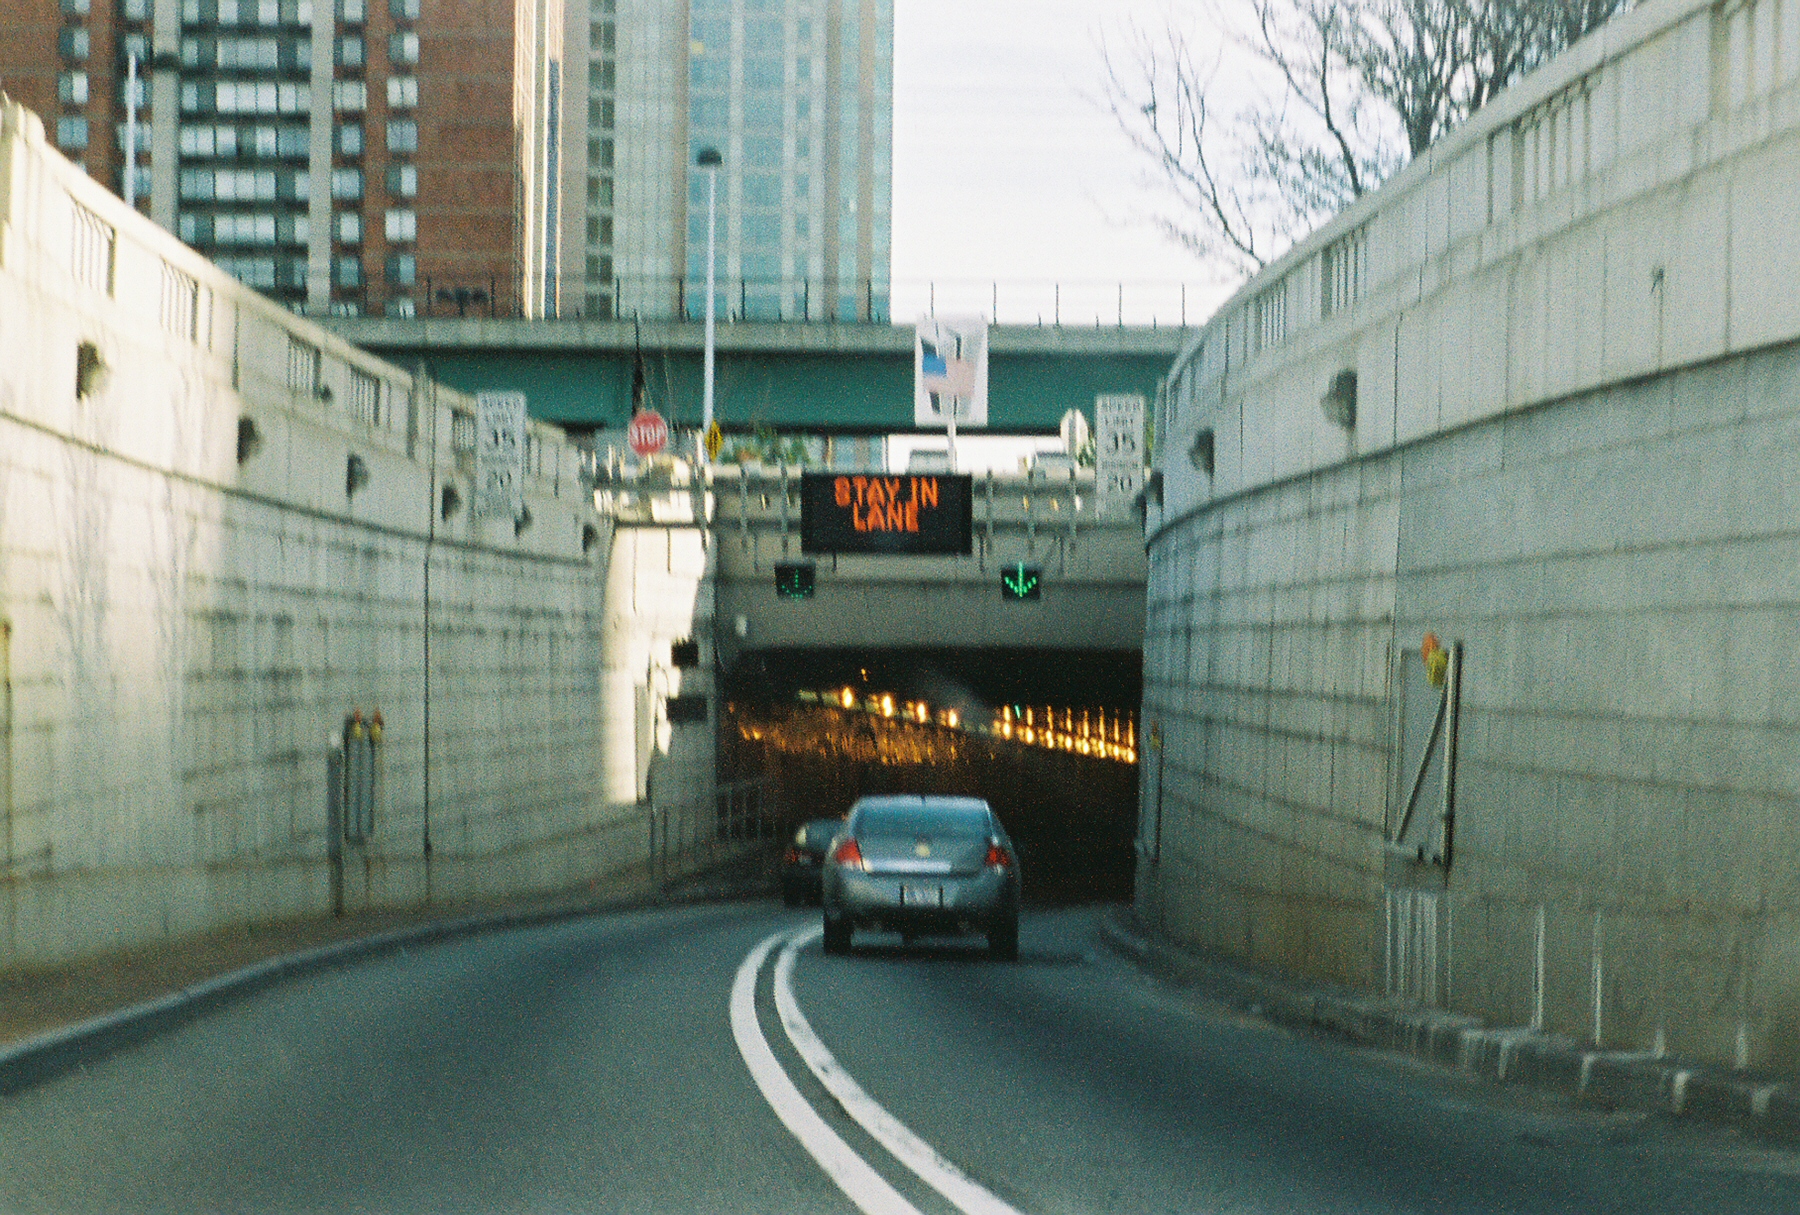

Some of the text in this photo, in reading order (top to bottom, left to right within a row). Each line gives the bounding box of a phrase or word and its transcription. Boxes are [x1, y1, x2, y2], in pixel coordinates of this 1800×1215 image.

[631, 424, 666, 446] STOP
[834, 475, 939, 508] STAY IN
[853, 500, 919, 533] LANE
